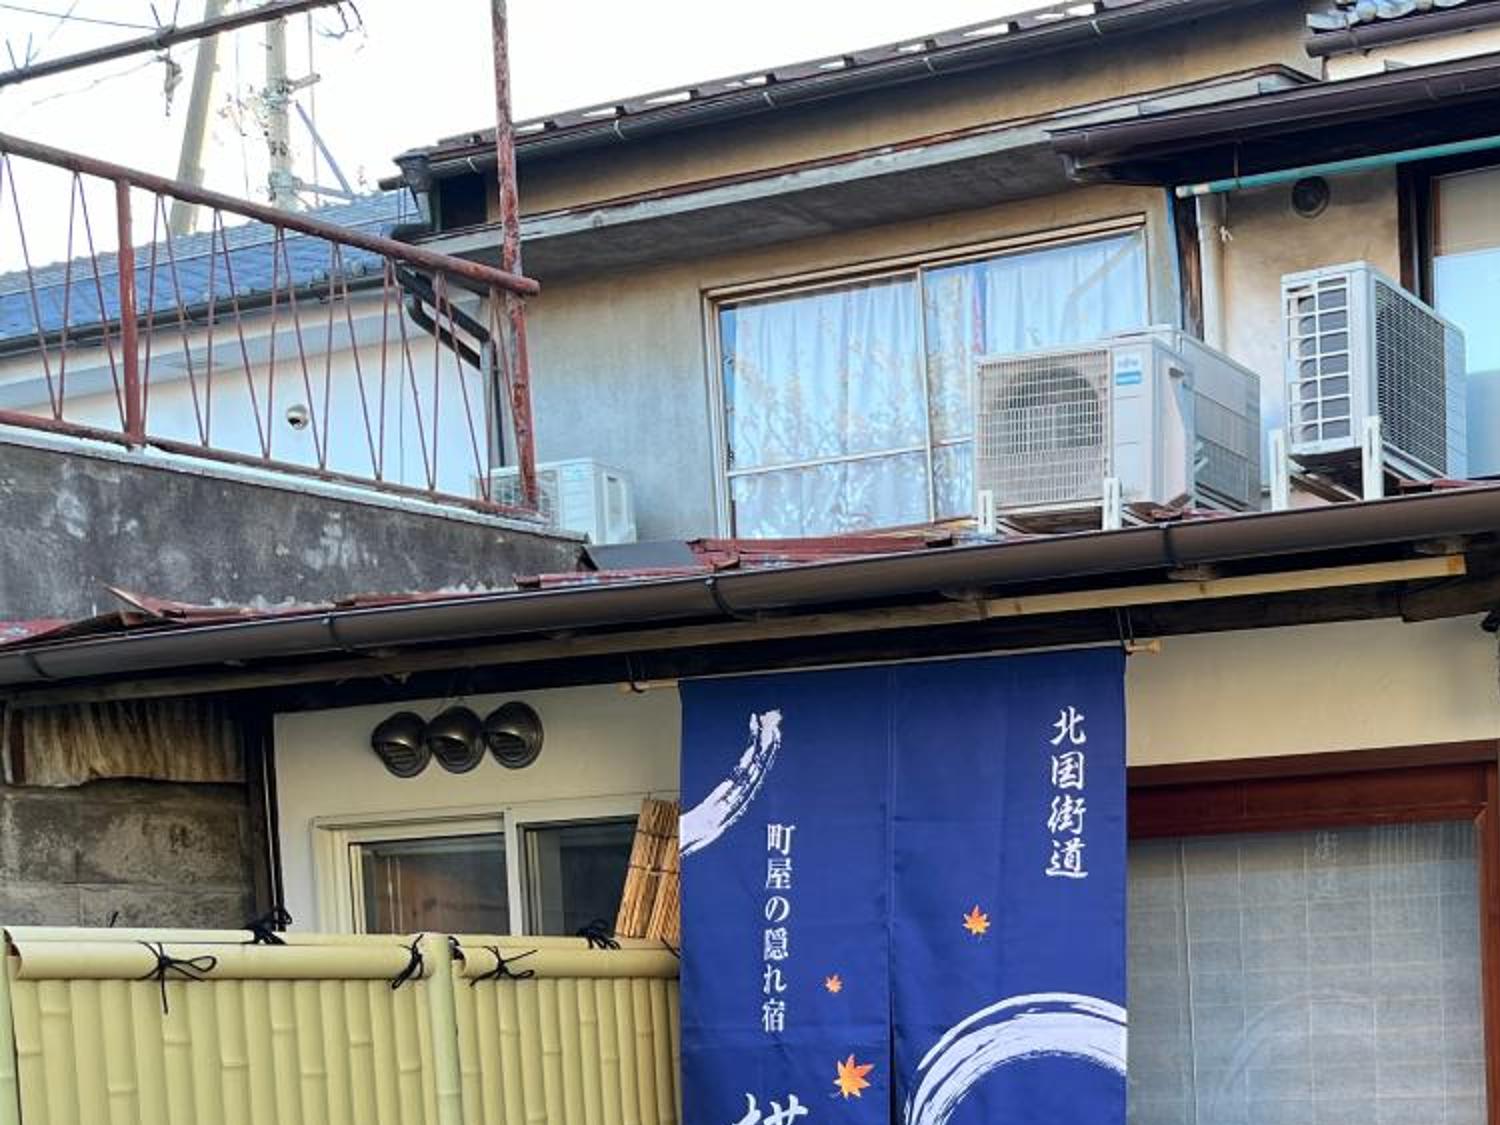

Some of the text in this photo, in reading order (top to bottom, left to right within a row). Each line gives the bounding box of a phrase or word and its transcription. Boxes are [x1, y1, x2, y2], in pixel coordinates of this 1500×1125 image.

[1045, 705, 1089, 879] 北国街道
[761, 823, 796, 1033] 町屋の隠れ宿
